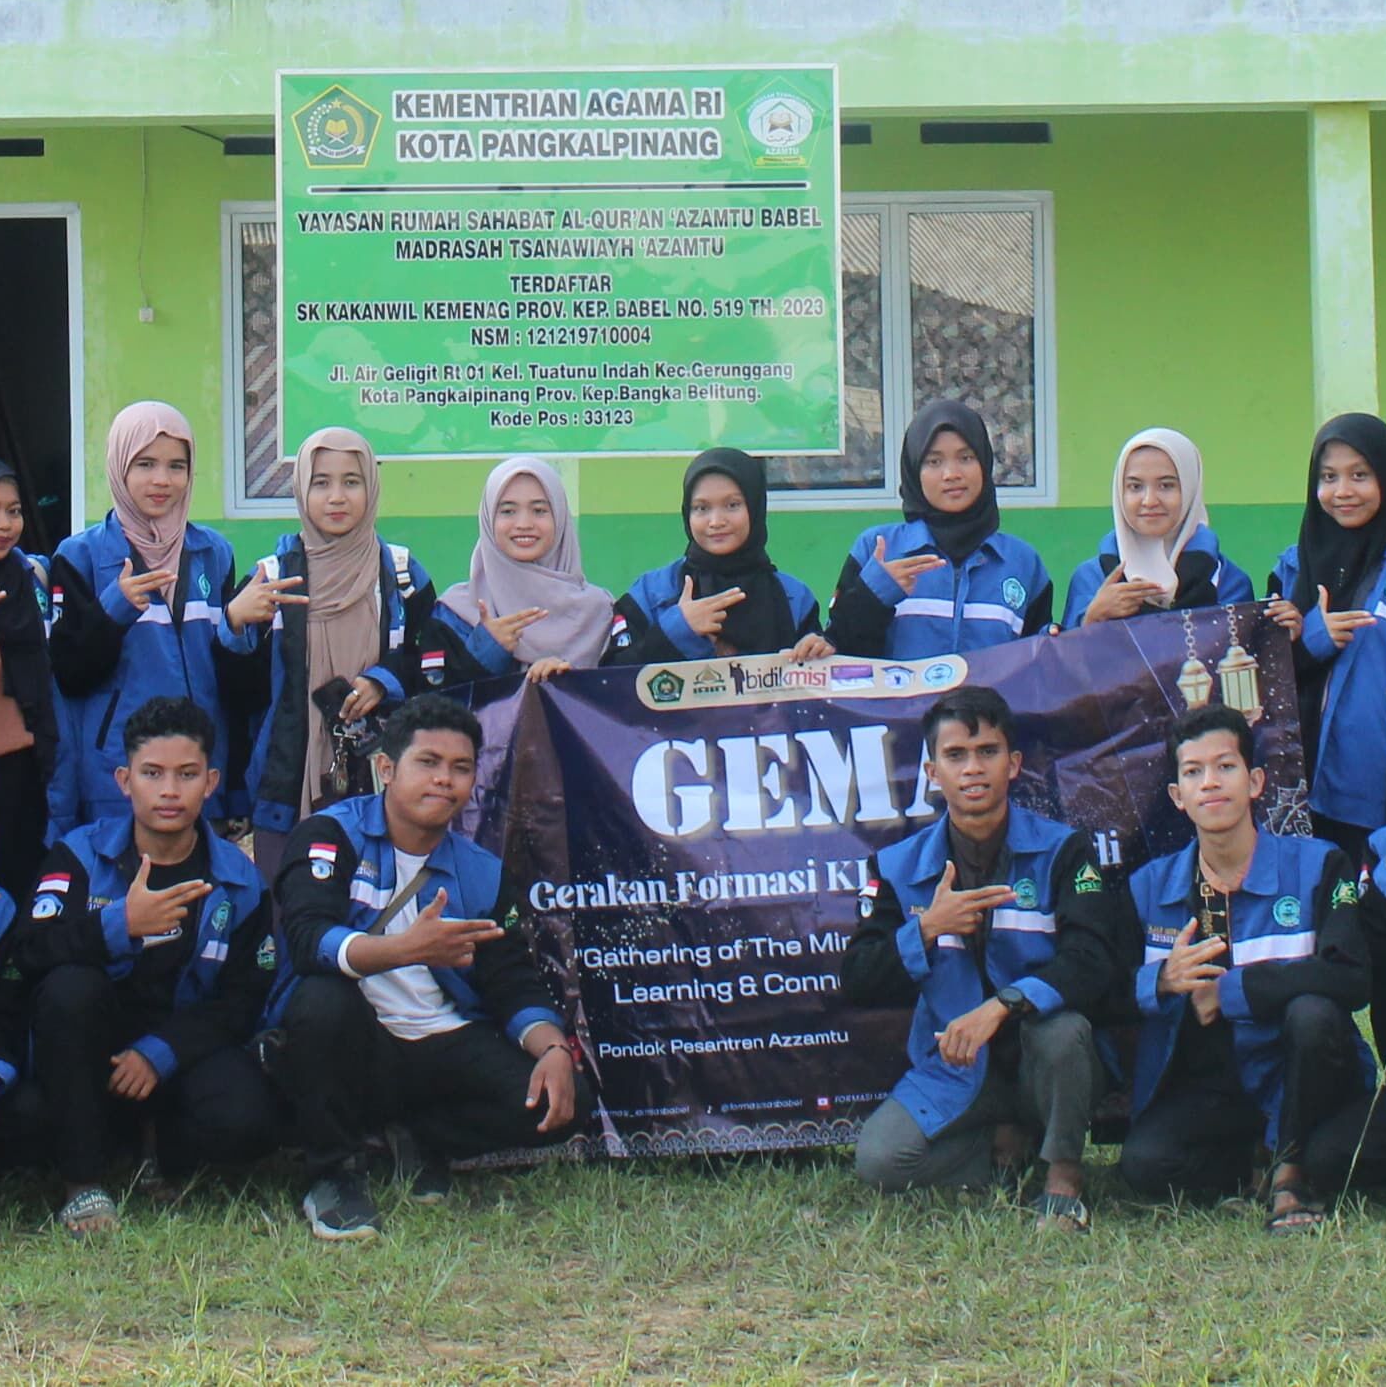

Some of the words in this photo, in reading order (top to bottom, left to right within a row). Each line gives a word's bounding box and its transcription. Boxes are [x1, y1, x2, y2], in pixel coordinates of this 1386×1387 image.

[395, 91, 577, 118] KEMENTRIAN
[586, 91, 686, 117] AGAMA
[695, 90, 721, 116] RI
[399, 133, 473, 159] KOTA
[482, 130, 719, 158] PANGKALPINANG
[298, 212, 384, 232] YAYASAN
[391, 211, 461, 231] RUMAH
[467, 210, 555, 230] SAHABAT
[761, 207, 822, 228] BABEL
[396, 239, 503, 259] MADRASAH
[509, 238, 634, 259] TSANAWIAYH
[510, 275, 611, 293] TERDAFTAR
[297, 303, 320, 321] SK
[326, 302, 417, 321] KAKANWIL
[424, 301, 510, 320] KEMENAG
[516, 300, 566, 319] PROV.
[573, 300, 610, 318] KEP.
[616, 299, 671, 317] BABEL
[677, 299, 707, 317] NO.
[713, 299, 743, 316] 519
[749, 299, 776, 316] TH.
[783, 298, 824, 316] 2023
[471, 328, 509, 345] NSM
[527, 327, 651, 345] 121219710004
[329, 366, 348, 382] Jl.
[355, 366, 377, 381] Air
[383, 365, 438, 384] Geligit
[443, 365, 462, 381] Rt
[466, 365, 485, 380] 01
[492, 364, 523, 380] Kel.
[528, 364, 597, 380] Tuatunu
[603, 363, 649, 379] Indah
[361, 388, 399, 403] Kota
[405, 387, 530, 406] Pangkalpinang
[536, 387, 576, 402] Prov.
[688, 385, 762, 403] Belitung.
[490, 411, 532, 426] Kode
[537, 411, 568, 426] Pos
[584, 410, 633, 425] 33123
[745, 666, 827, 690] bidikmisi
[529, 873, 669, 911] Gerakan
[673, 859, 818, 903] Formasi
[825, 859, 867, 892] KI
[718, 938, 744, 960] of
[746, 936, 802, 957] The
[614, 976, 734, 1004] Learning
[739, 975, 757, 997] &
[763, 972, 841, 995] Conn
[599, 1040, 667, 1059] Pondok
[670, 1035, 764, 1055] Pesantren
[768, 1029, 849, 1049] Azzamtu
